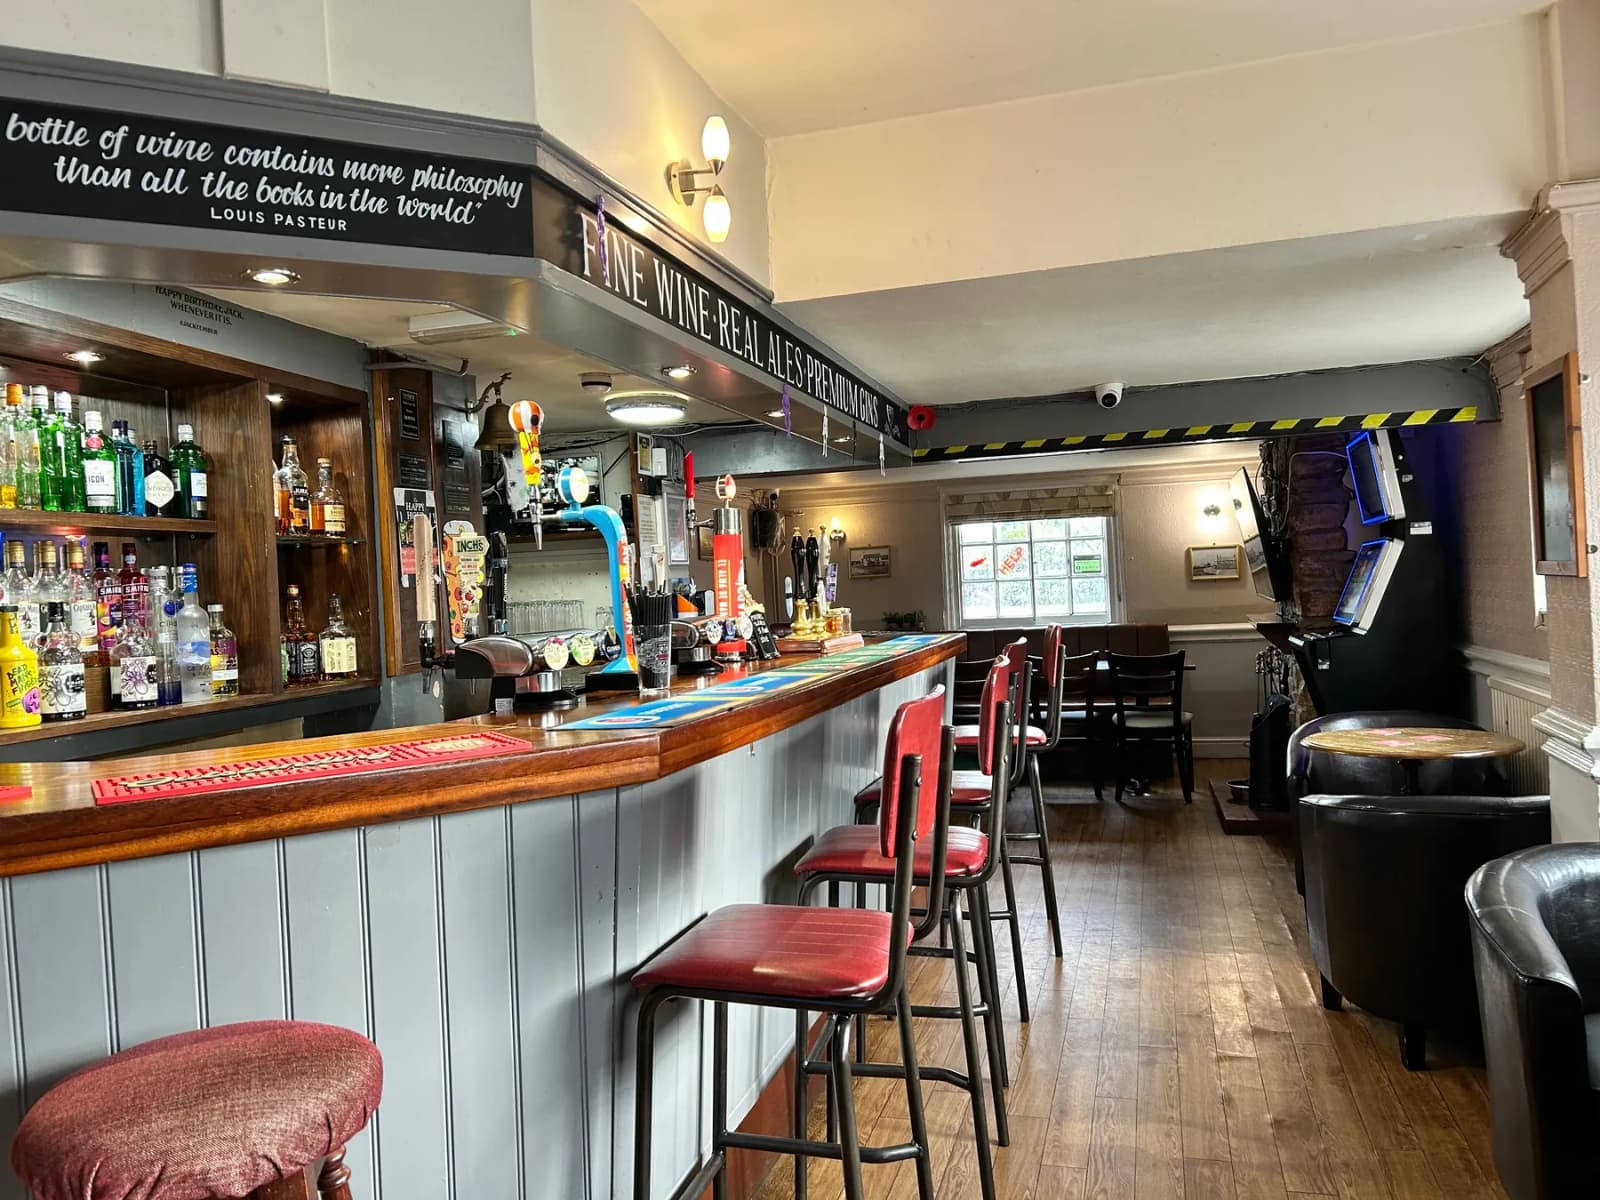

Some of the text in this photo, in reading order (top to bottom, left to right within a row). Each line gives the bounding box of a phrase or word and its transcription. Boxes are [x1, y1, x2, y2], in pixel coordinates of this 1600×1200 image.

[6, 113, 524, 209] bottle of wine contains more philosophy
[53, 155, 132, 189] than
[140, 168, 189, 195] all
[200, 171, 249, 201] the
[255, 176, 315, 207] books
[319, 184, 347, 209] in
[349, 188, 389, 214] the
[210, 207, 348, 231] LOUIS PASTEUR
[170, 299, 214, 321] WHENEVER
[580, 212, 880, 428] FINE WINE REAL ALES PREMIUM GINS
[405, 502, 424, 511] HAPPY
[999, 546, 1025, 575] HELP
